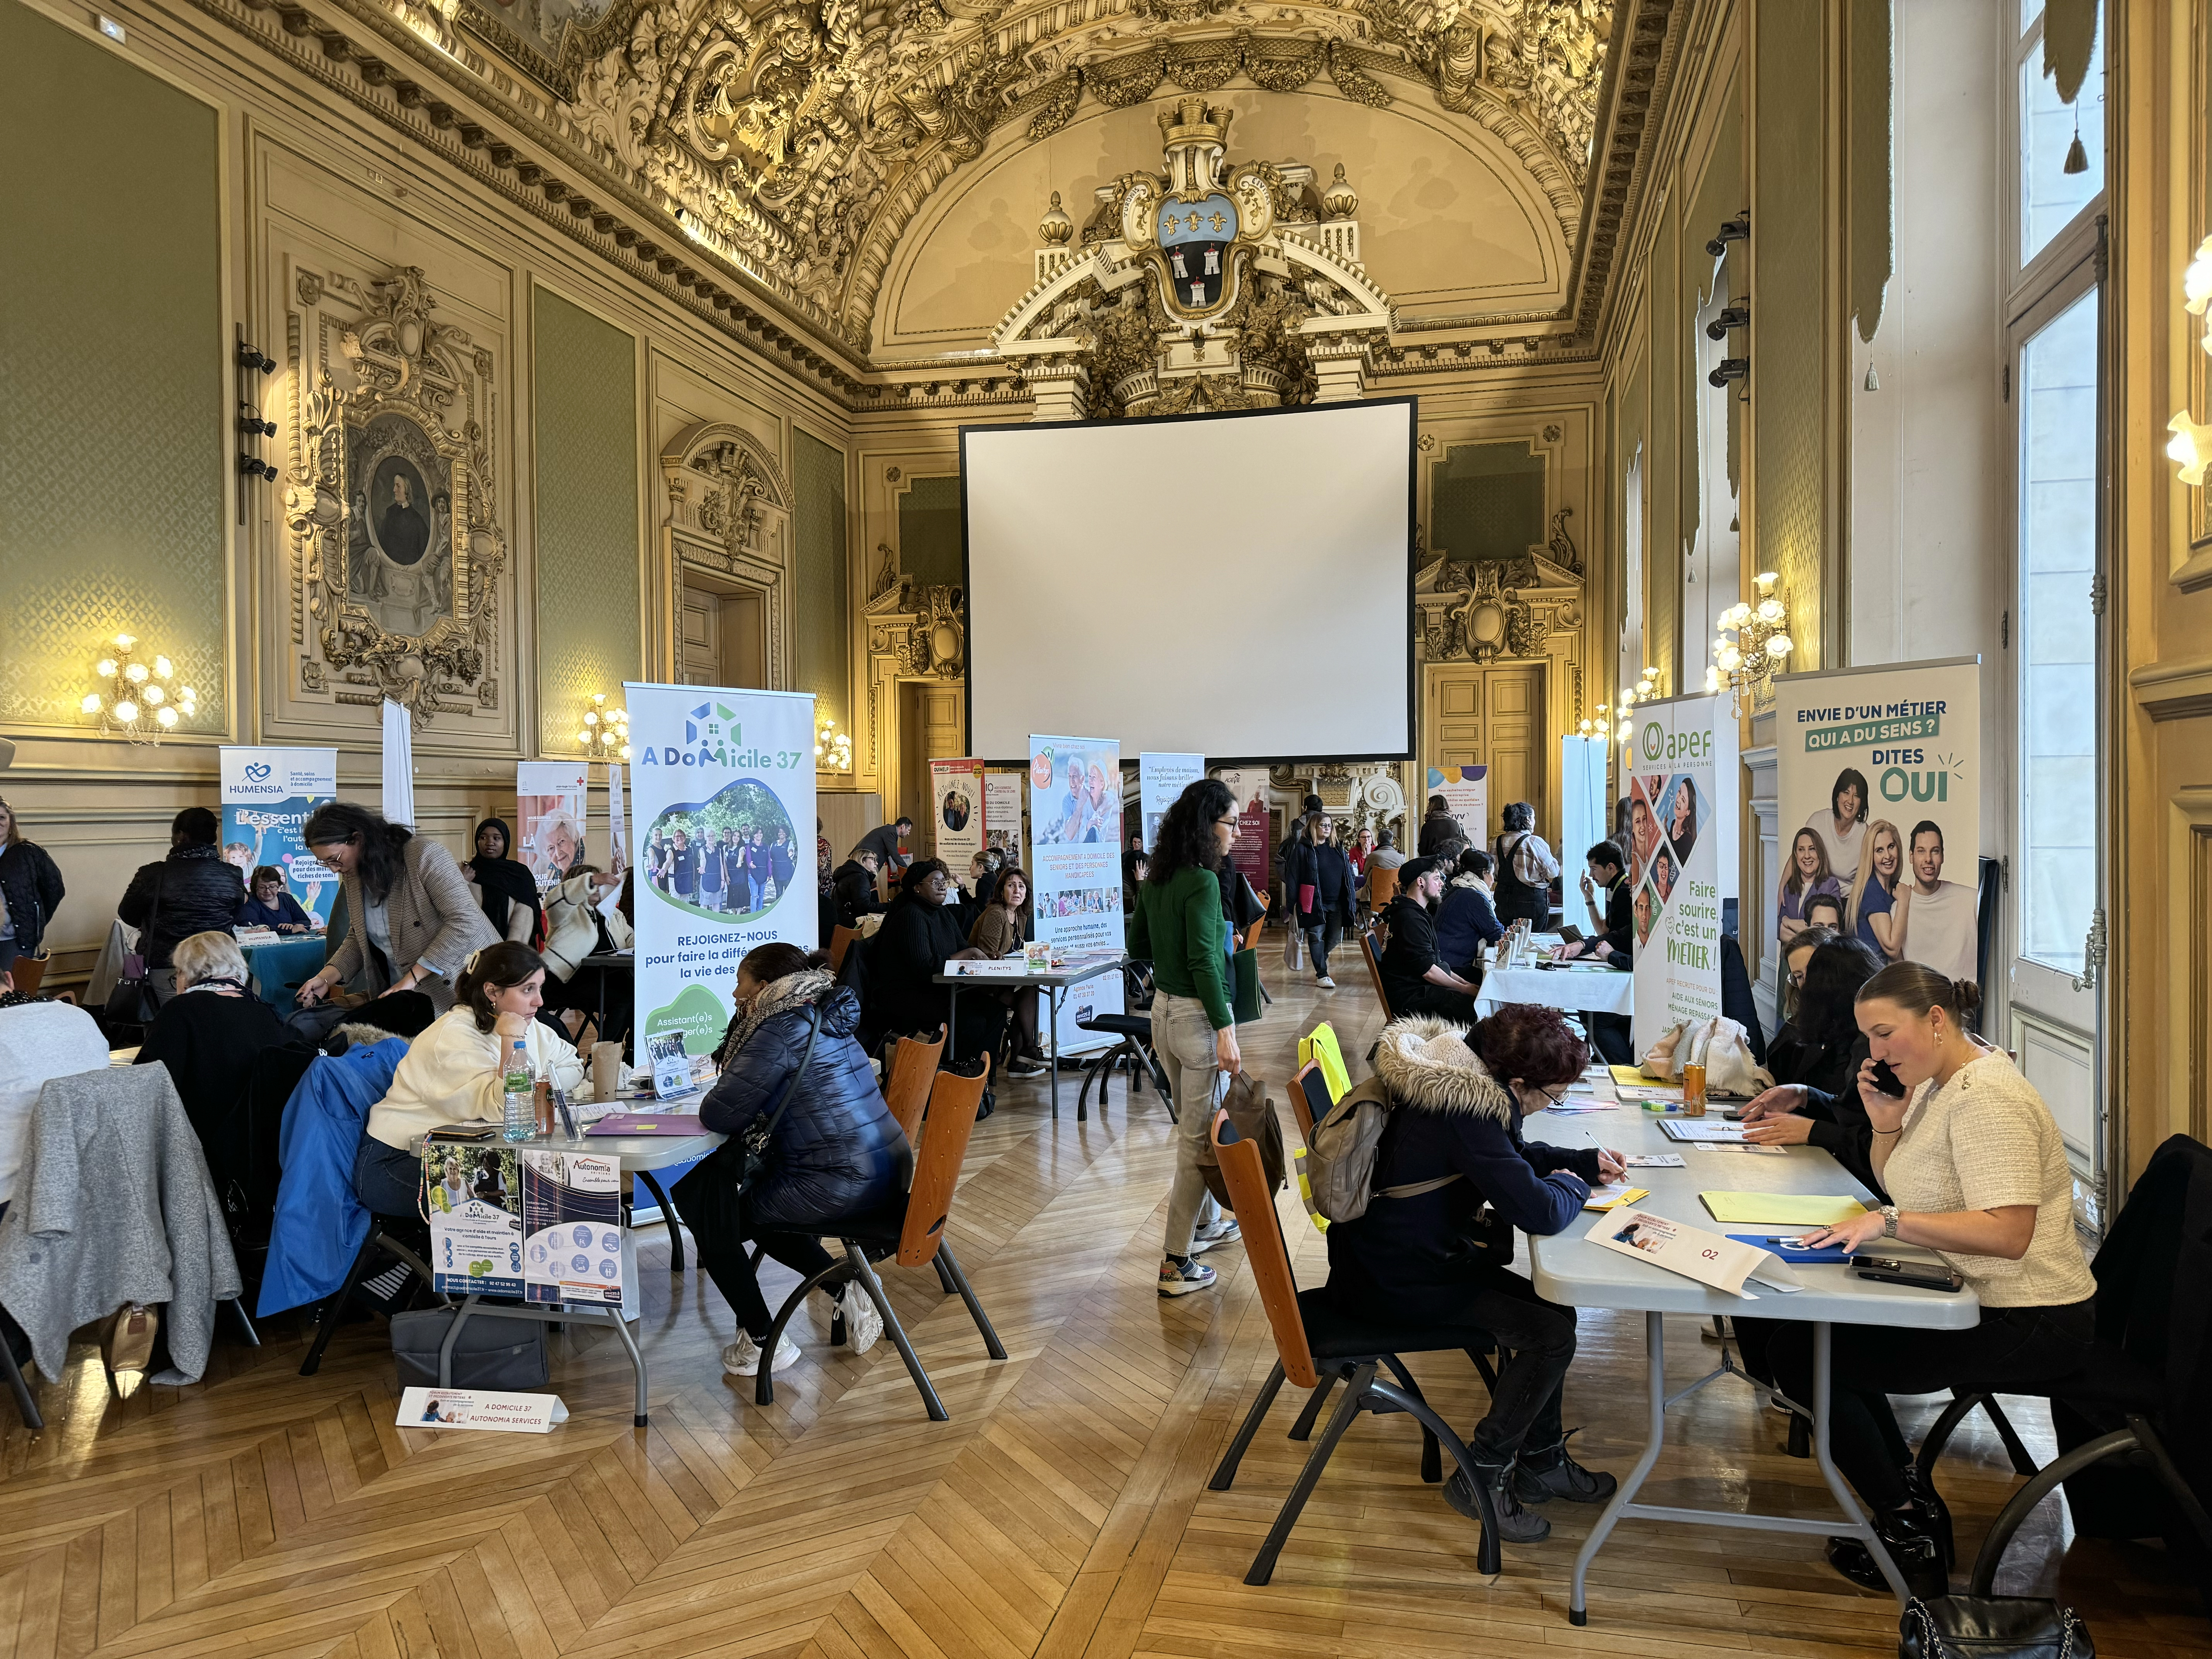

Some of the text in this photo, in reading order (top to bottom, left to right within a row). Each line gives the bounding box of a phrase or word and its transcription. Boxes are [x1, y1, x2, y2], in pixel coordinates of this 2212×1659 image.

[1252, 178, 1270, 205] CIVITAS
[1124, 187, 1139, 217] TURONIS
[1797, 699, 1946, 722] ENVIE D'UN MÉTIER
[1808, 719, 1936, 748] QUI A DU SENS ?
[1667, 730, 1712, 759] apef
[641, 747, 658, 765] A
[776, 751, 802, 769] 37
[1872, 748, 1924, 765] DITES
[1159, 773, 1177, 781] faisons
[1880, 766, 1948, 802] OUI
[523, 833, 536, 847] LÀ
[1690, 881, 1716, 898] Faire
[1679, 902, 1719, 924] sourire,
[1064, 925, 1082, 933] approche
[1068, 932, 1094, 942] personnalisés
[1676, 921, 1716, 941] c'est un
[678, 930, 778, 946] REJOIGNEZ-NOUS
[646, 950, 719, 967] pour faire la
[1667, 936, 1716, 971] MÉTIER !
[680, 965, 735, 978] la vie des
[1677, 979, 1695, 989] RECRUTE
[1696, 985, 1707, 993] POUR
[1672, 992, 1718, 1010] AIDE AUX SÉNIORS
[658, 1012, 712, 1026] Assistant(e)s
[1668, 1003, 1717, 1020] MÉNAGE REPASSAG
[573, 1160, 610, 1172] Autonomia
